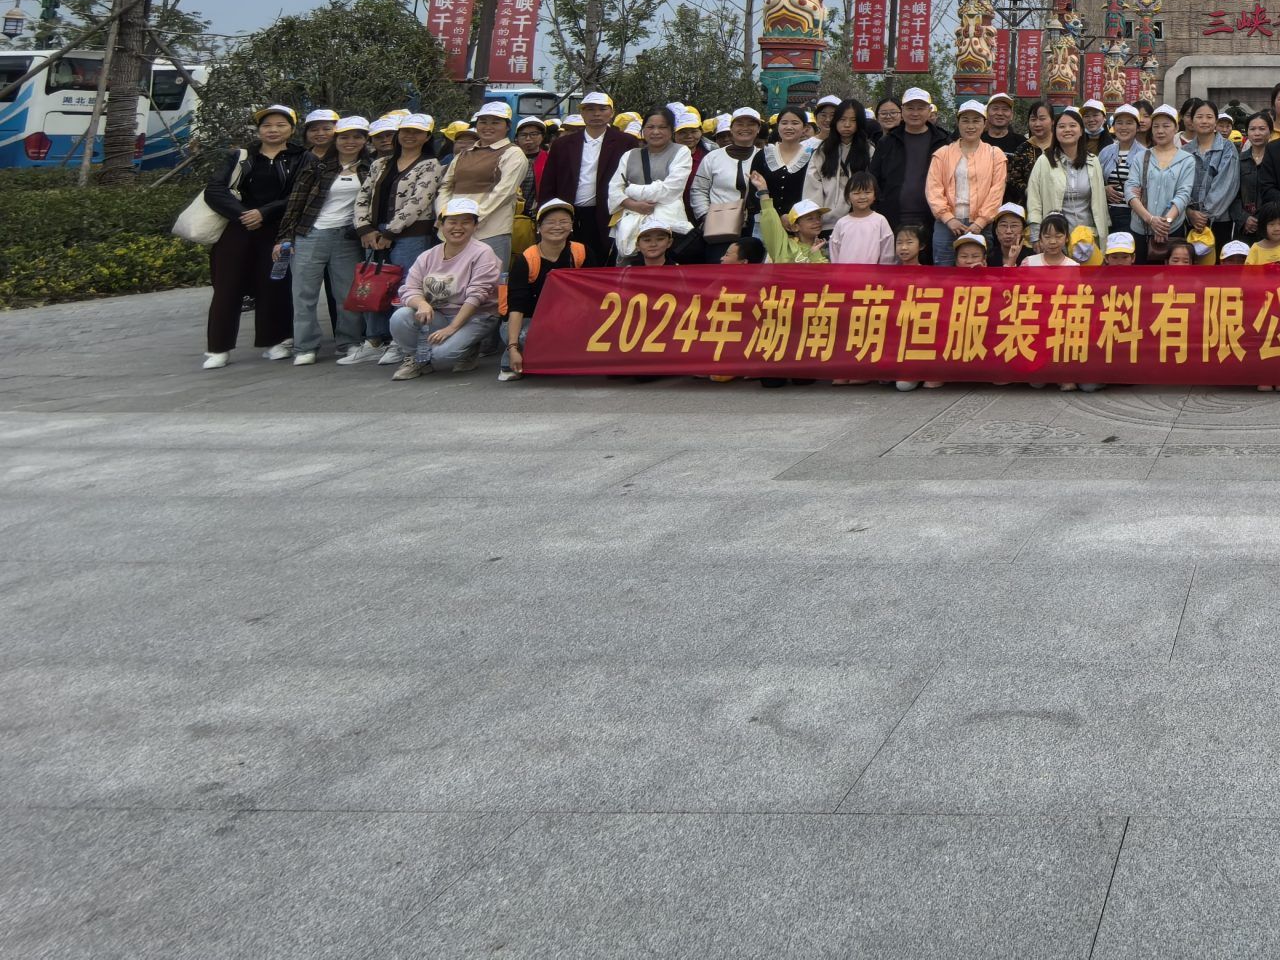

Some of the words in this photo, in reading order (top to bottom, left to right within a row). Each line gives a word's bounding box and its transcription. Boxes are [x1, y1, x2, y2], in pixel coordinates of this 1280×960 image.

[1026, 35, 1039, 91] 三峡千古情
